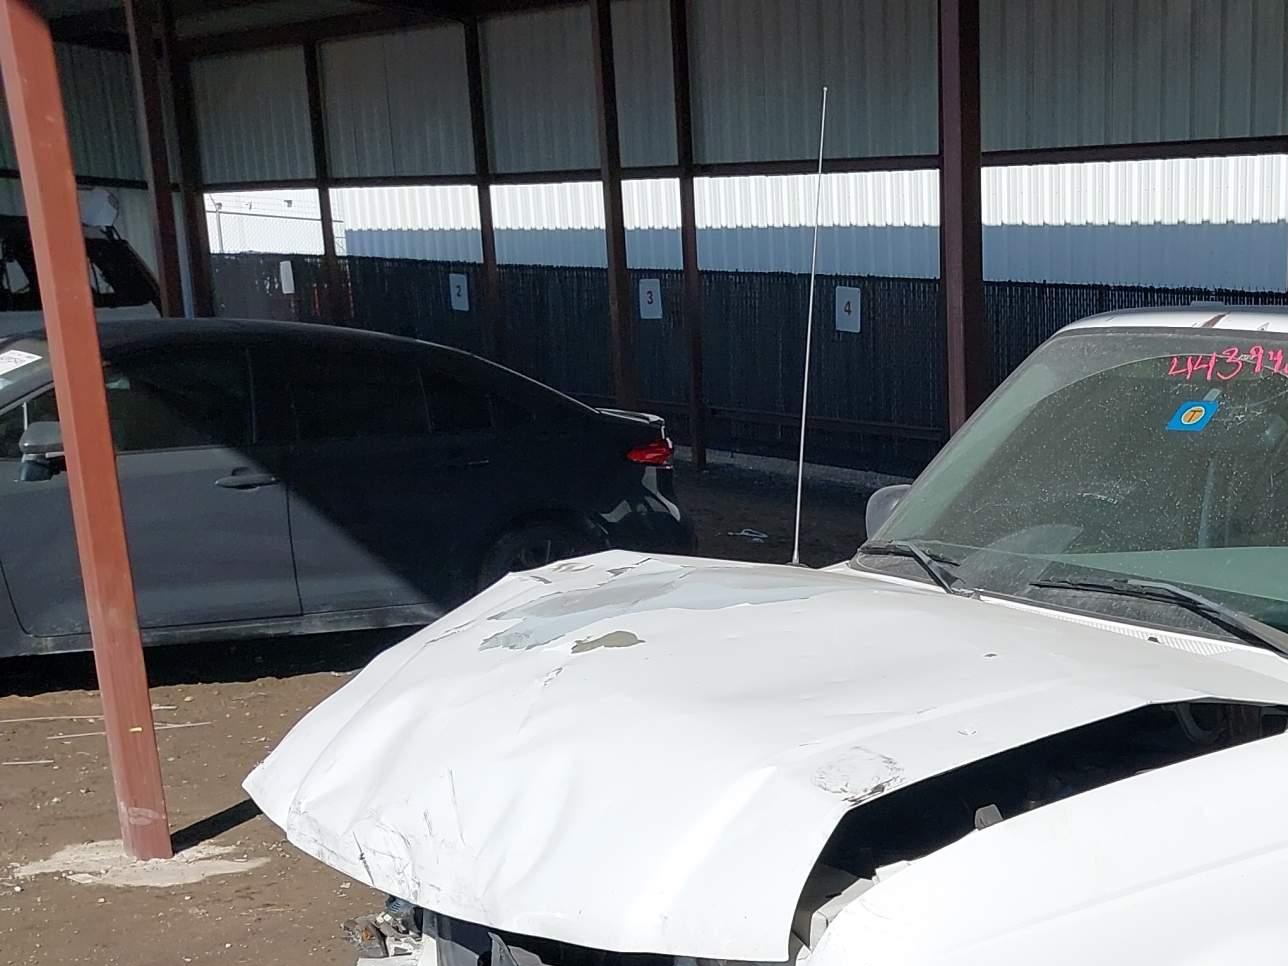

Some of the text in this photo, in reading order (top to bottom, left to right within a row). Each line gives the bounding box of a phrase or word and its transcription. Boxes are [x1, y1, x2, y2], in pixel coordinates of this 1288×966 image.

[455, 284, 463, 298] 2
[646, 290, 655, 305] 3
[843, 300, 852, 317] 4
